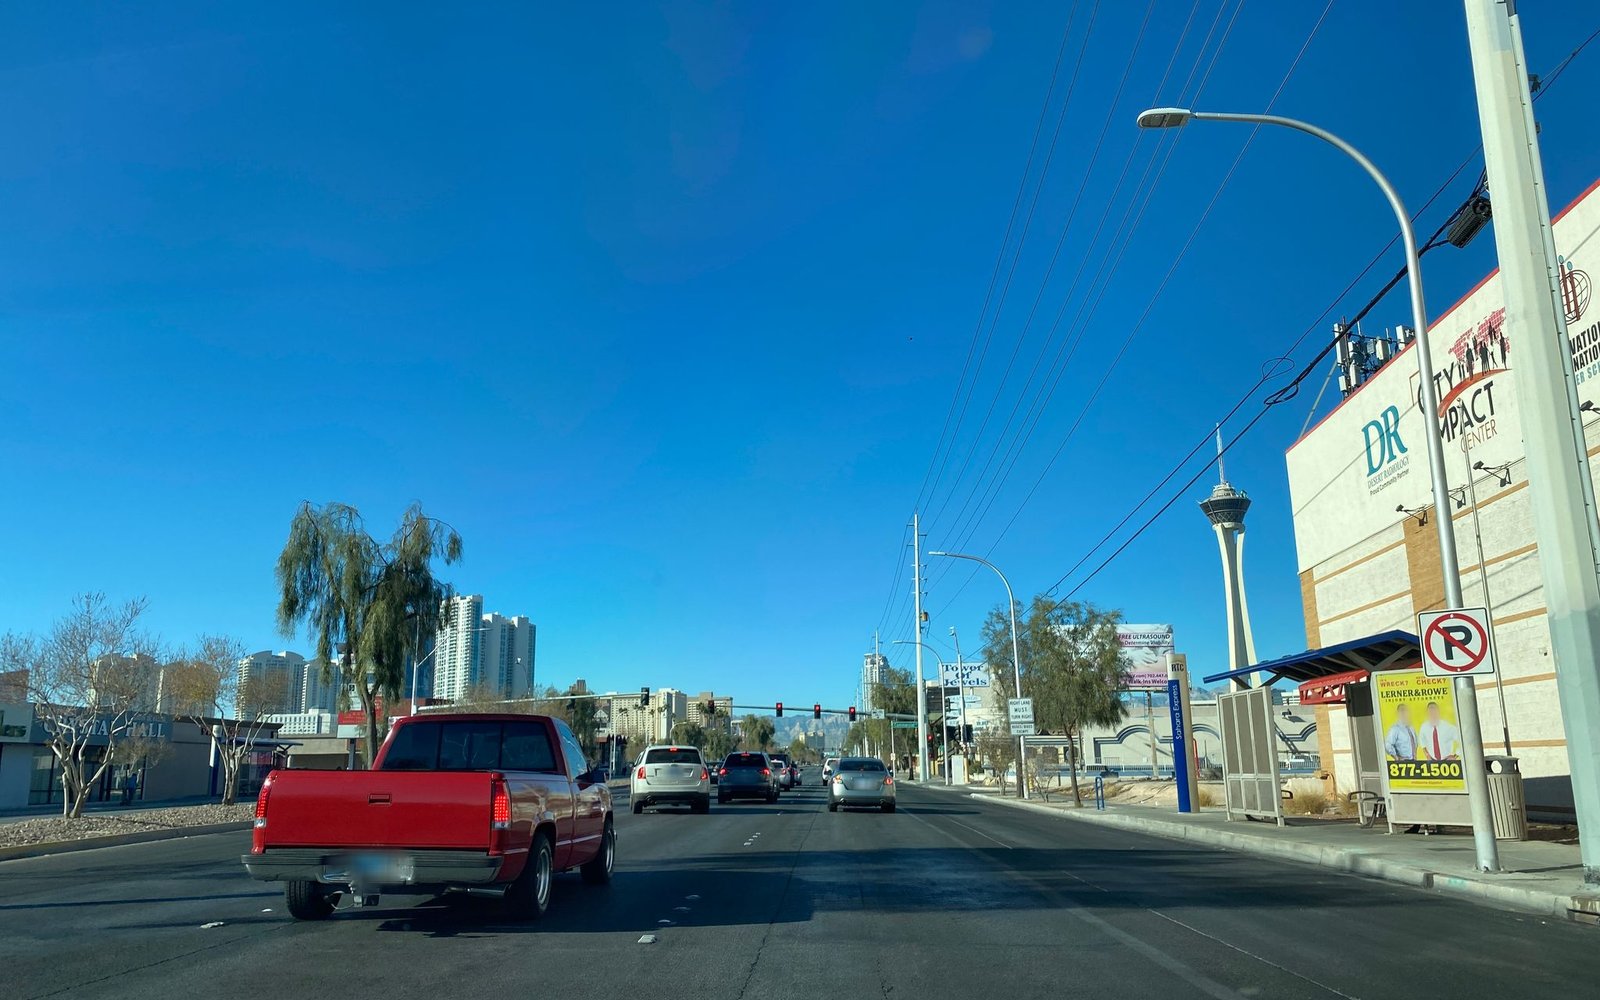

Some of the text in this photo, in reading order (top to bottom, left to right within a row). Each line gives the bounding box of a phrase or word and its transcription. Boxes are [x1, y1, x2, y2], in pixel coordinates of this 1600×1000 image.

[1569, 321, 1600, 355] VATIO
[1573, 342, 1600, 372] NATIO
[1439, 380, 1494, 442] MPACT
[1361, 405, 1408, 477] DR
[1461, 419, 1497, 453] CENTER
[942, 664, 984, 672] Tower
[1171, 663, 1184, 672] RTC
[944, 678, 987, 686] Jewels
[1380, 680, 1409, 688] WRECK?
[1416, 678, 1447, 686] CHECK?
[1380, 687, 1448, 699] LERNER&ROWE
[1389, 763, 1460, 777] 877-1500
